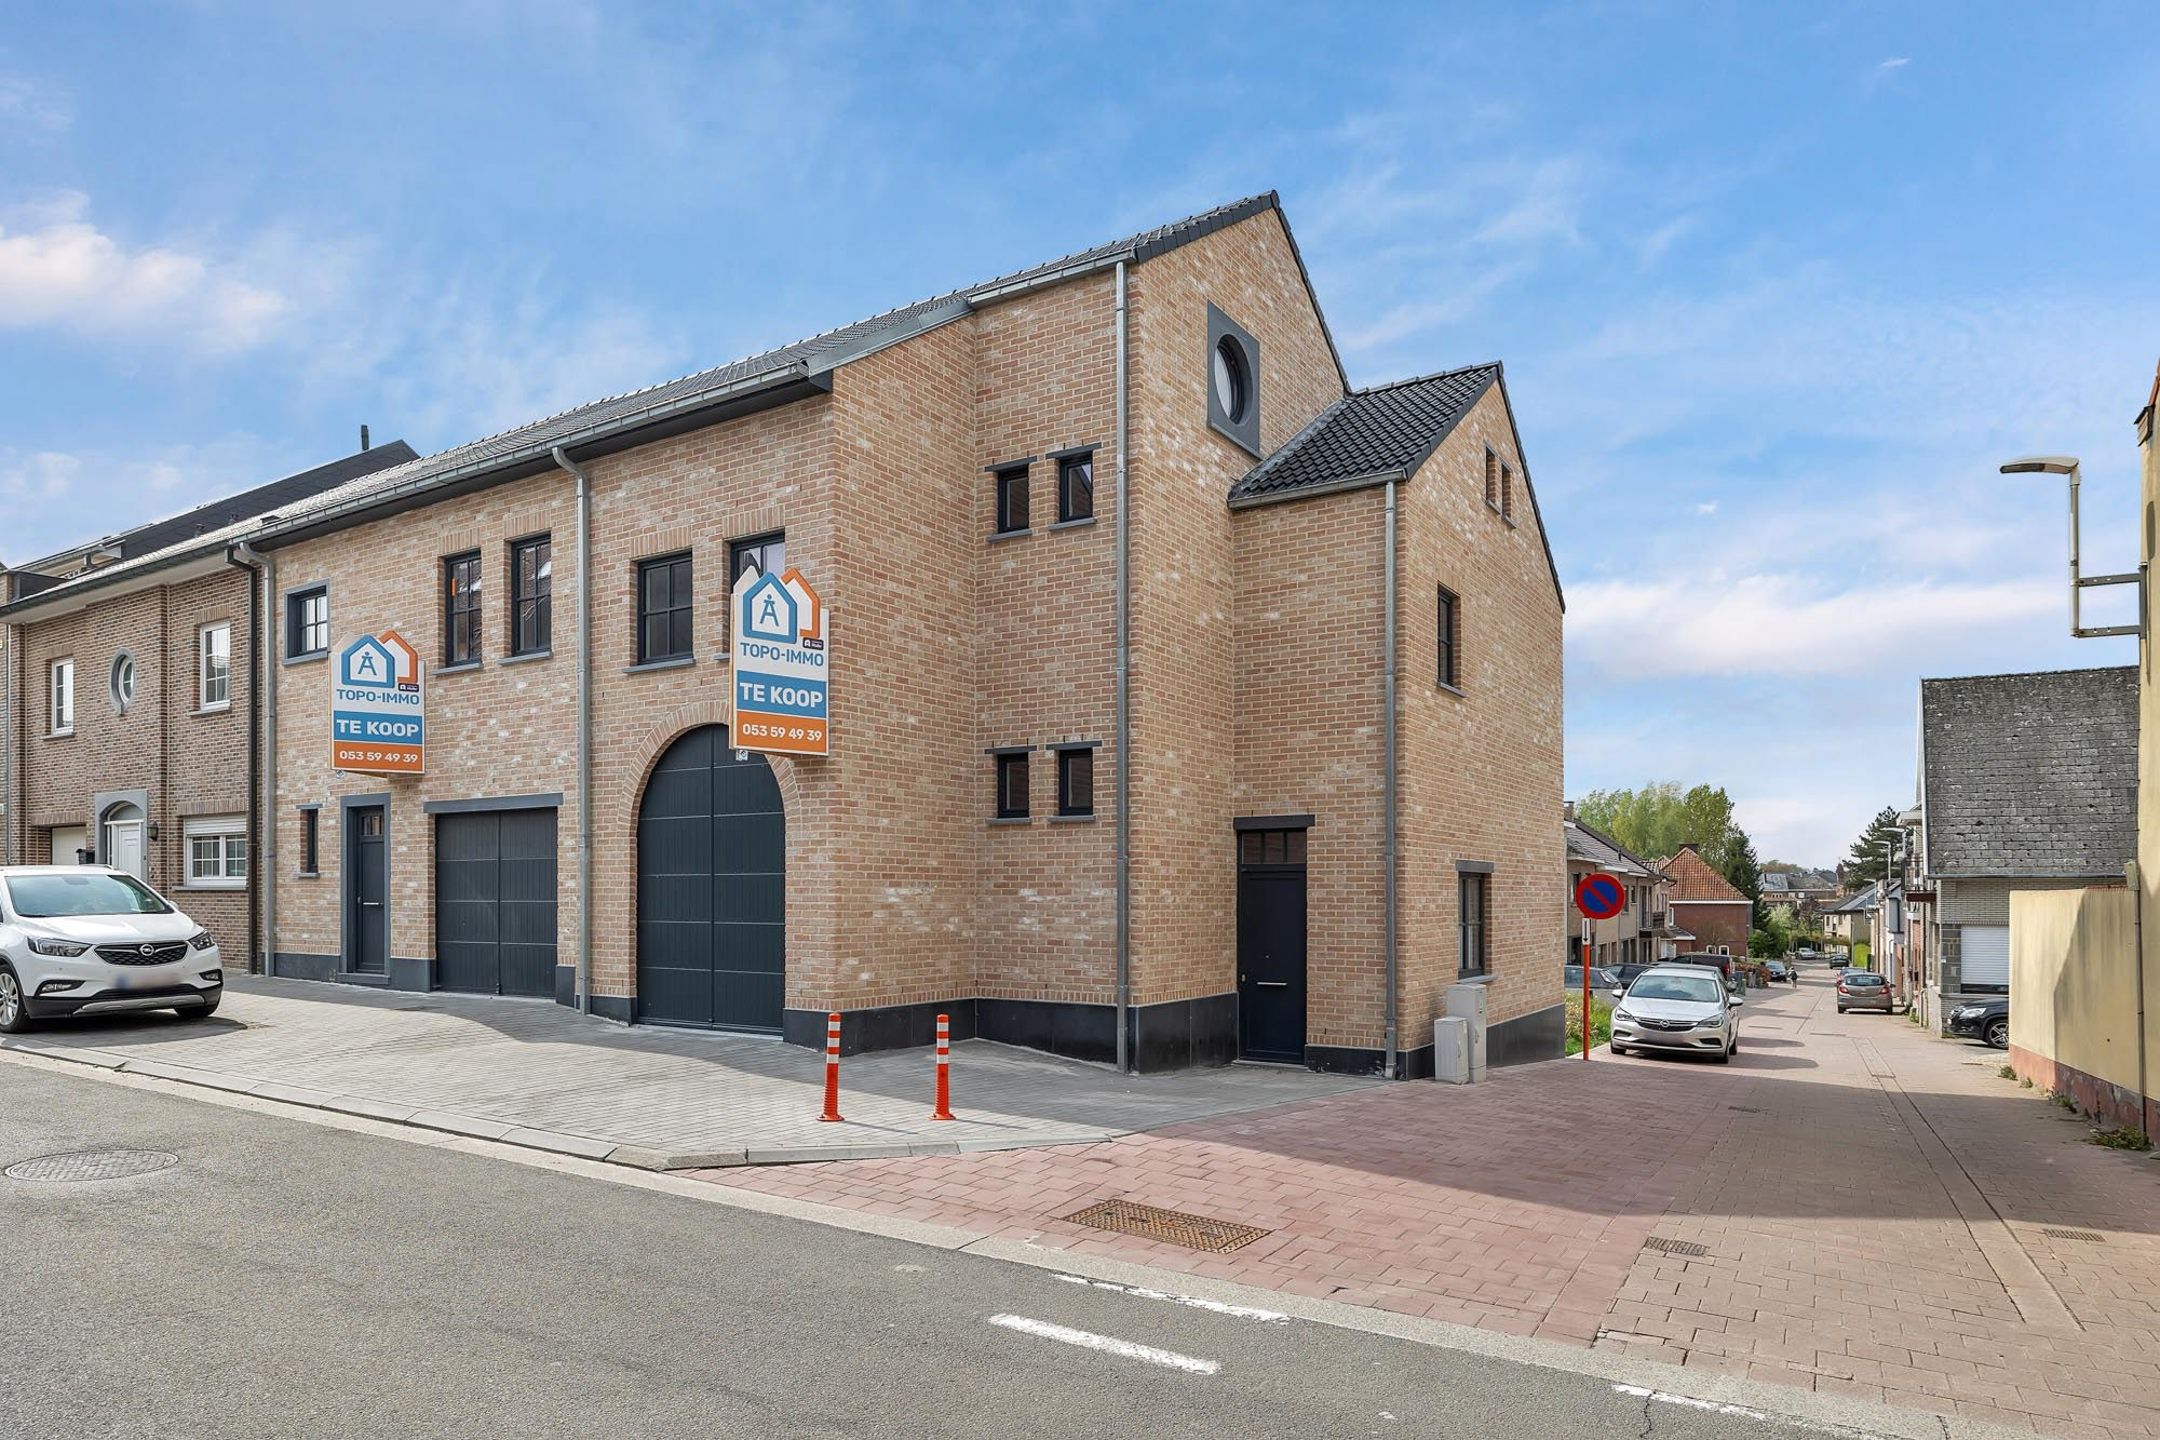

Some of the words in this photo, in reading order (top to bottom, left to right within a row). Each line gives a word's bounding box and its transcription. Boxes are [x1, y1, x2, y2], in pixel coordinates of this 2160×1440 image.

[740, 643, 823, 666] TOPO-IMMO
[336, 690, 419, 705] TOPO-IMMO
[740, 683, 765, 702] TE
[770, 686, 823, 707] KOOP
[337, 720, 362, 734] TE
[367, 721, 418, 737] KOOP
[742, 723, 767, 737] 053
[770, 726, 785, 738] 59
[788, 727, 804, 740] 49
[807, 729, 822, 741] 39
[340, 750, 364, 761] 053
[367, 752, 382, 762] 59
[384, 752, 400, 763] 49
[403, 753, 418, 764] 39
